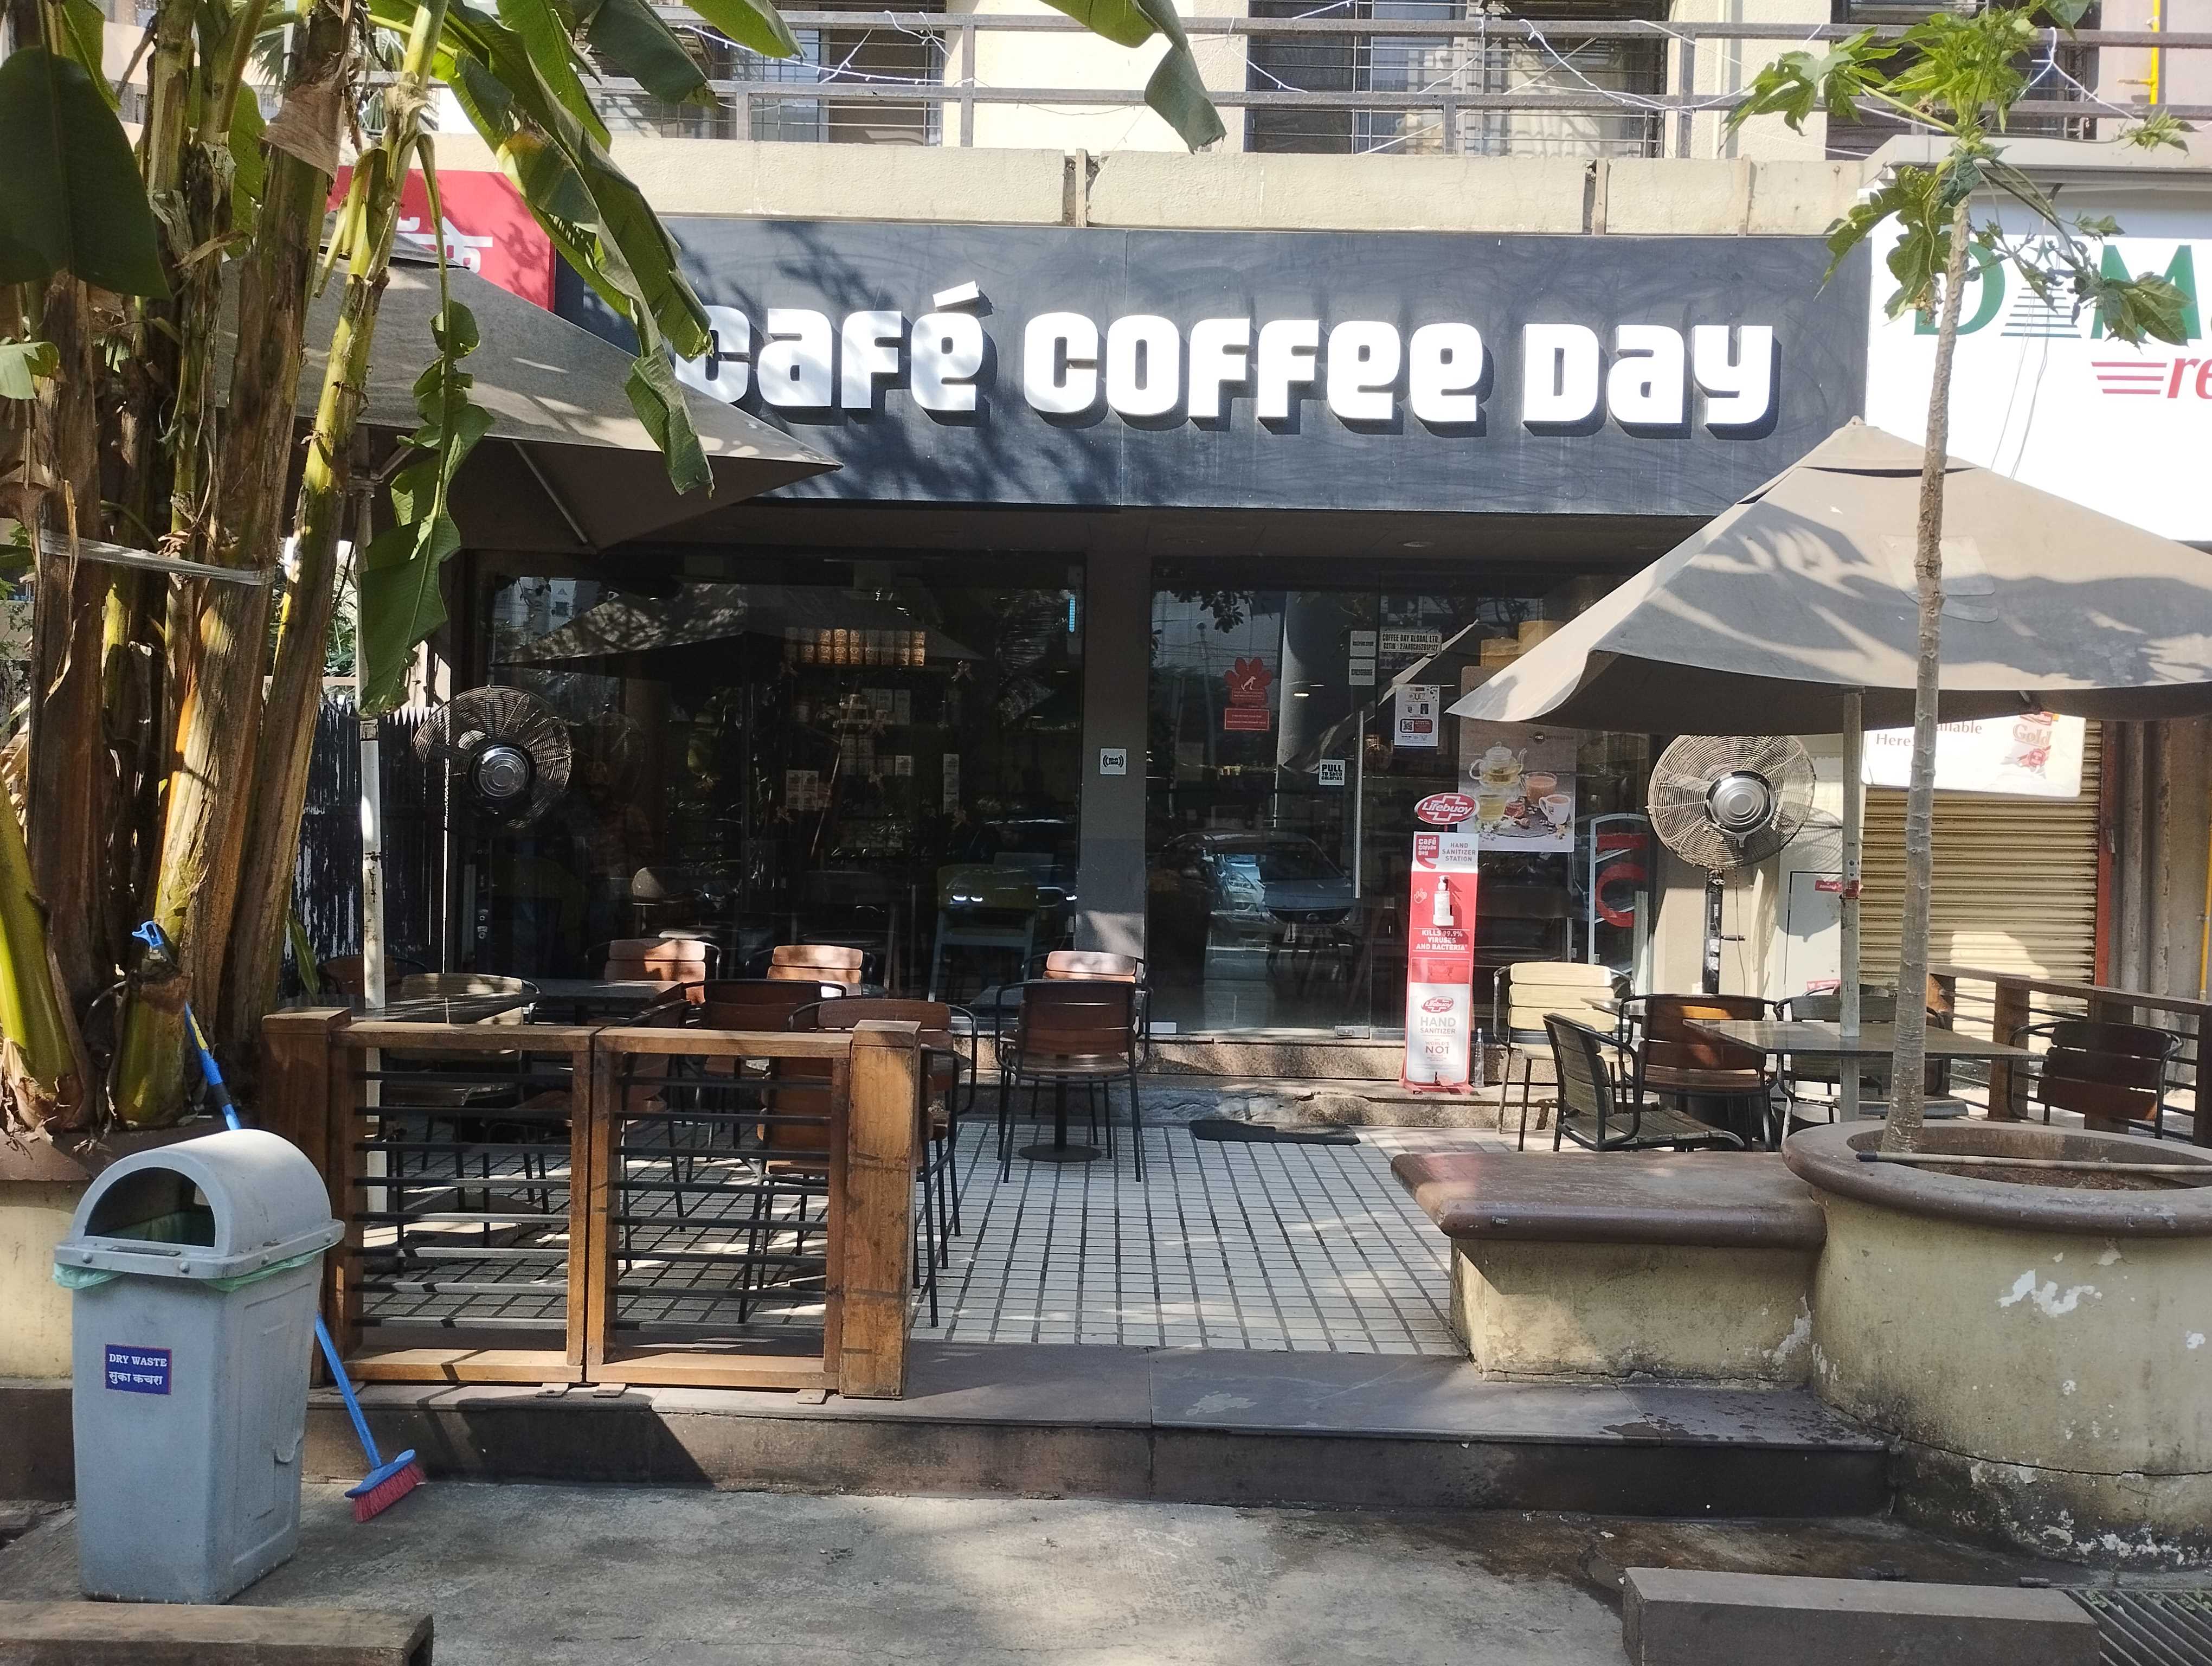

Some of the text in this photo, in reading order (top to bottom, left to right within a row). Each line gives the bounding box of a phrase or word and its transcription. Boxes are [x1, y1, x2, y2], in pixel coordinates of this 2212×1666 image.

[2013, 724, 2052, 746] Gold
[1422, 802, 1472, 815] Lifebuoy
[1420, 1016, 1456, 1027] HAND
[109, 1353, 167, 1367] DRY WASTE
[109, 1370, 163, 1386] सुका कचरा
